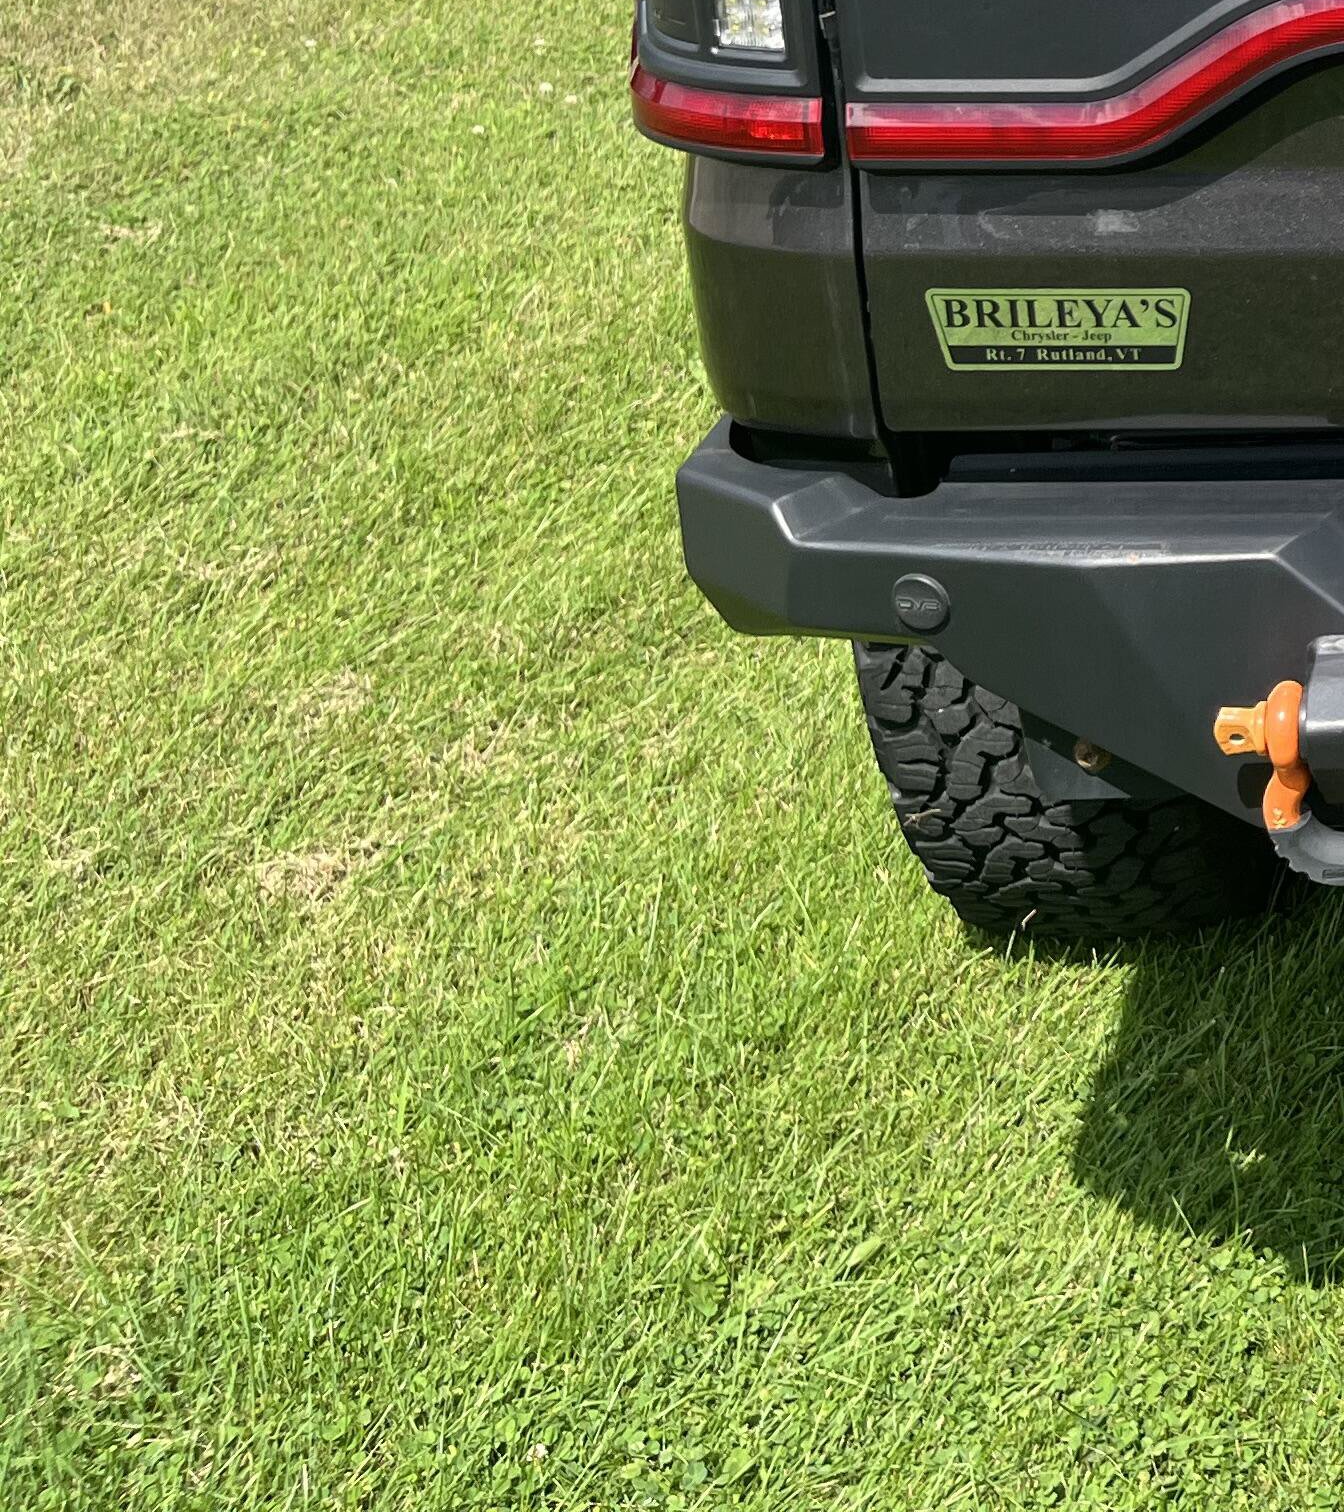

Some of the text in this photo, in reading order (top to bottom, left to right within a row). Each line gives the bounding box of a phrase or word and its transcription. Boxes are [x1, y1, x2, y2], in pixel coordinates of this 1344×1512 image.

[942, 298, 1178, 329] BRILEYA'S
[1011, 329, 1068, 344] Chrysler
[1081, 329, 1112, 344] Jeep
[986, 347, 1011, 361] Rt.
[1016, 347, 1025, 361] 7
[1117, 347, 1142, 362] VT
